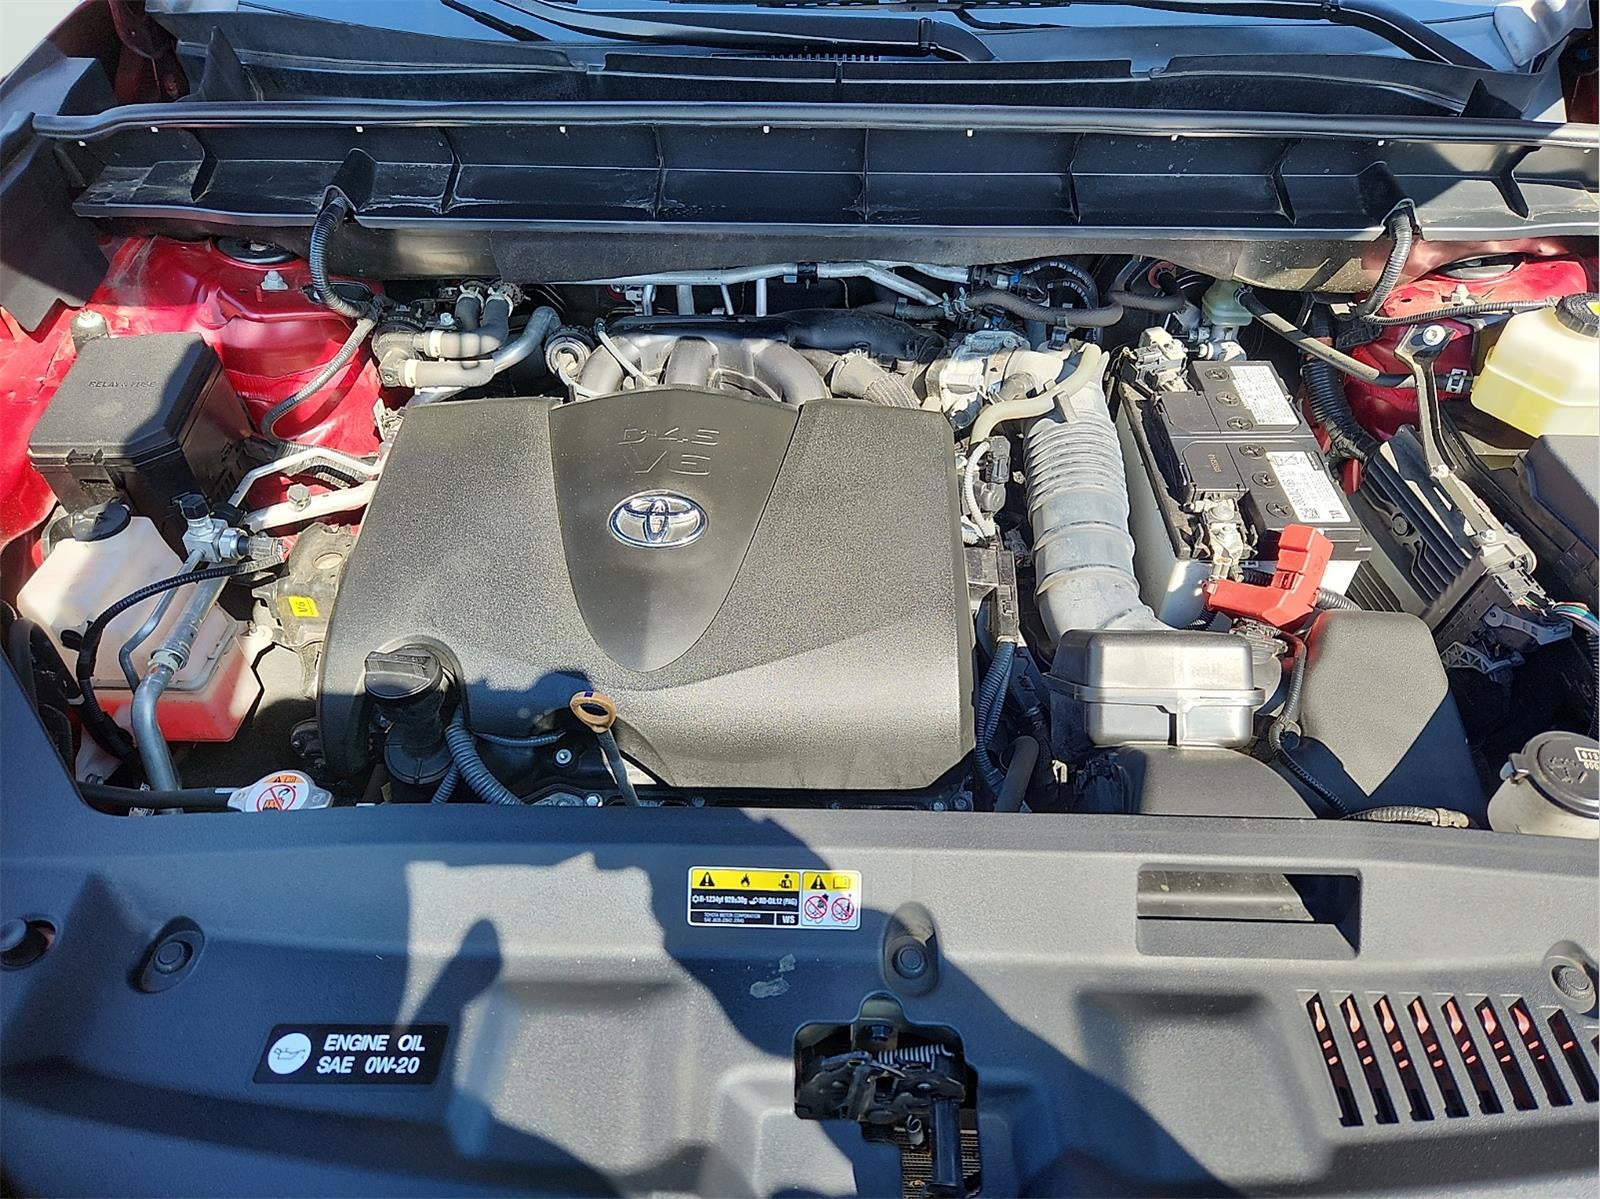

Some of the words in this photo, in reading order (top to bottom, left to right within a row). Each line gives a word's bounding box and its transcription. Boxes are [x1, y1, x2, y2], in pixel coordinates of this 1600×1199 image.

[782, 915, 796, 924] WS
[323, 1034, 390, 1051] ENGINE
[397, 1034, 426, 1052] OIL
[316, 1055, 355, 1074] SAE
[364, 1056, 420, 1074] 0W-20
